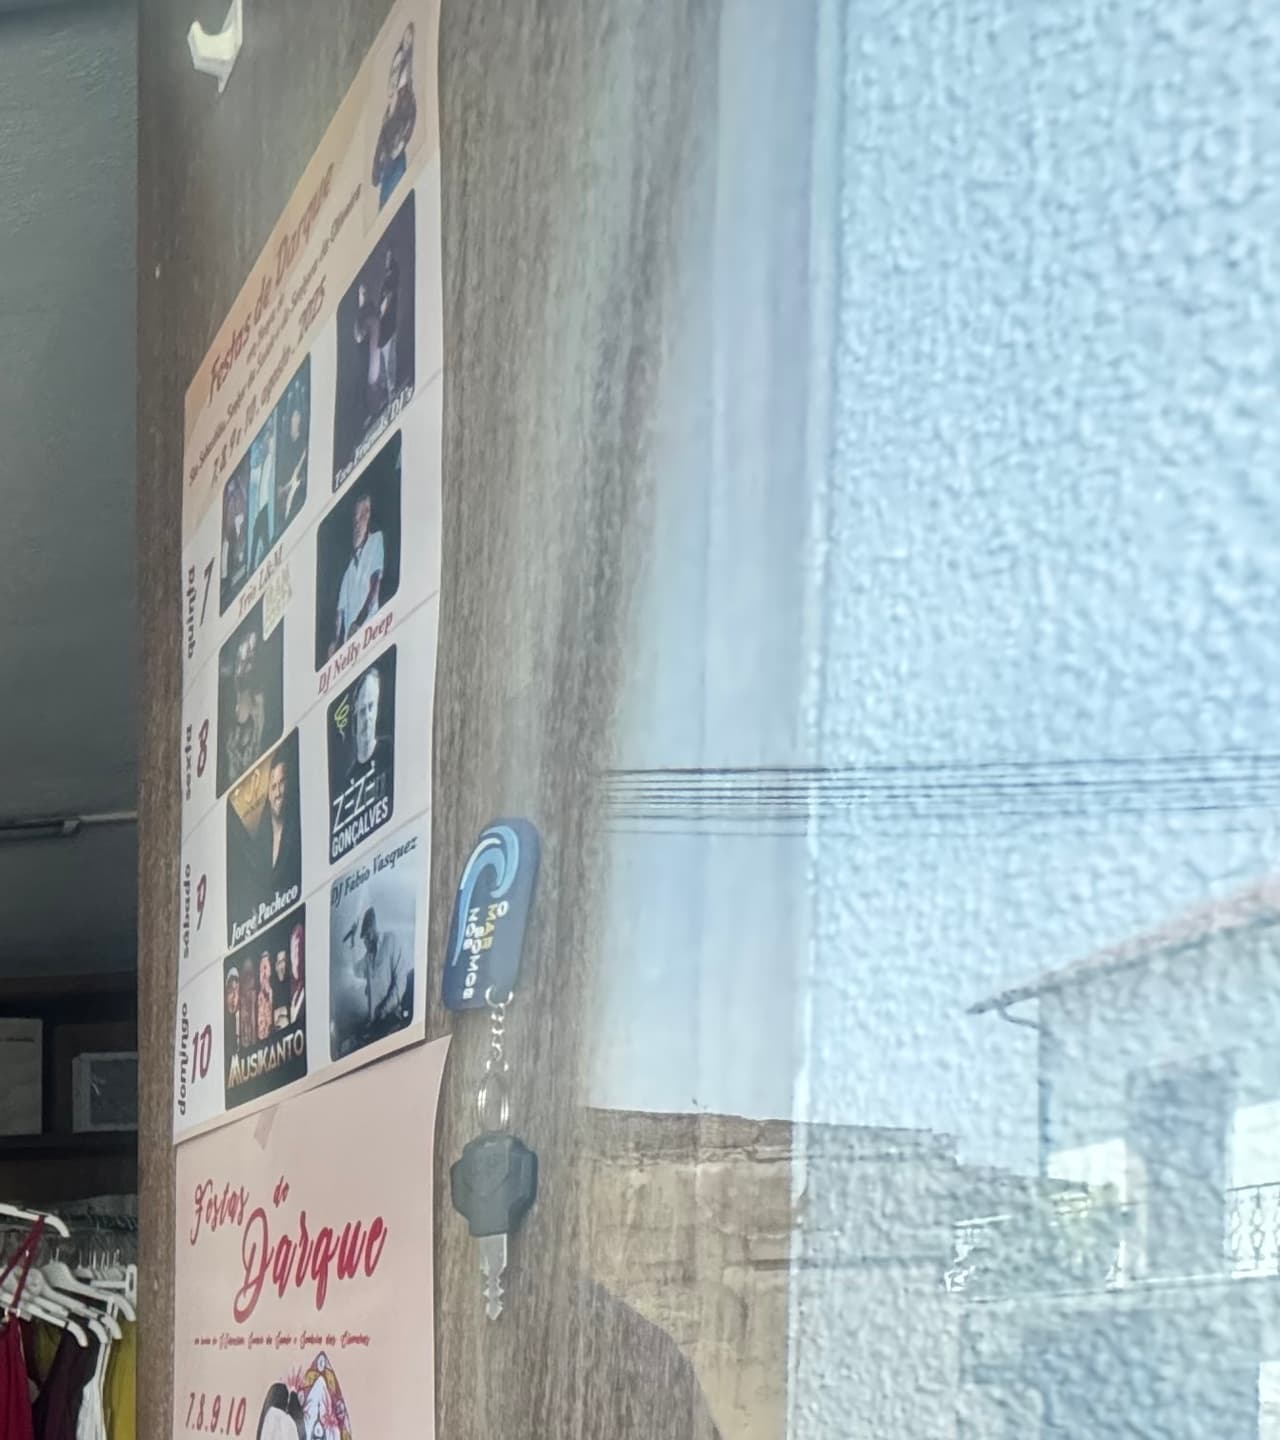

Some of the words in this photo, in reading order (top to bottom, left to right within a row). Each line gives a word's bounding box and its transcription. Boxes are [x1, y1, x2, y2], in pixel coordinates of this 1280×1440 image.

[200, 556, 215, 627] 7
[318, 665, 331, 696] DJ
[362, 611, 393, 651] Deep
[197, 718, 210, 779] 8
[331, 795, 389, 858] GONÇALVES
[196, 873, 207, 932] 9
[228, 914, 258, 951] Jorge
[258, 885, 299, 925] Pacheco
[178, 1001, 190, 1116] domingo
[191, 1023, 213, 1085] 10
[227, 1028, 304, 1089] MUSIKANTO
[232, 1206, 389, 1325] Darque
[184, 1390, 247, 1438] 7.8.9.10
